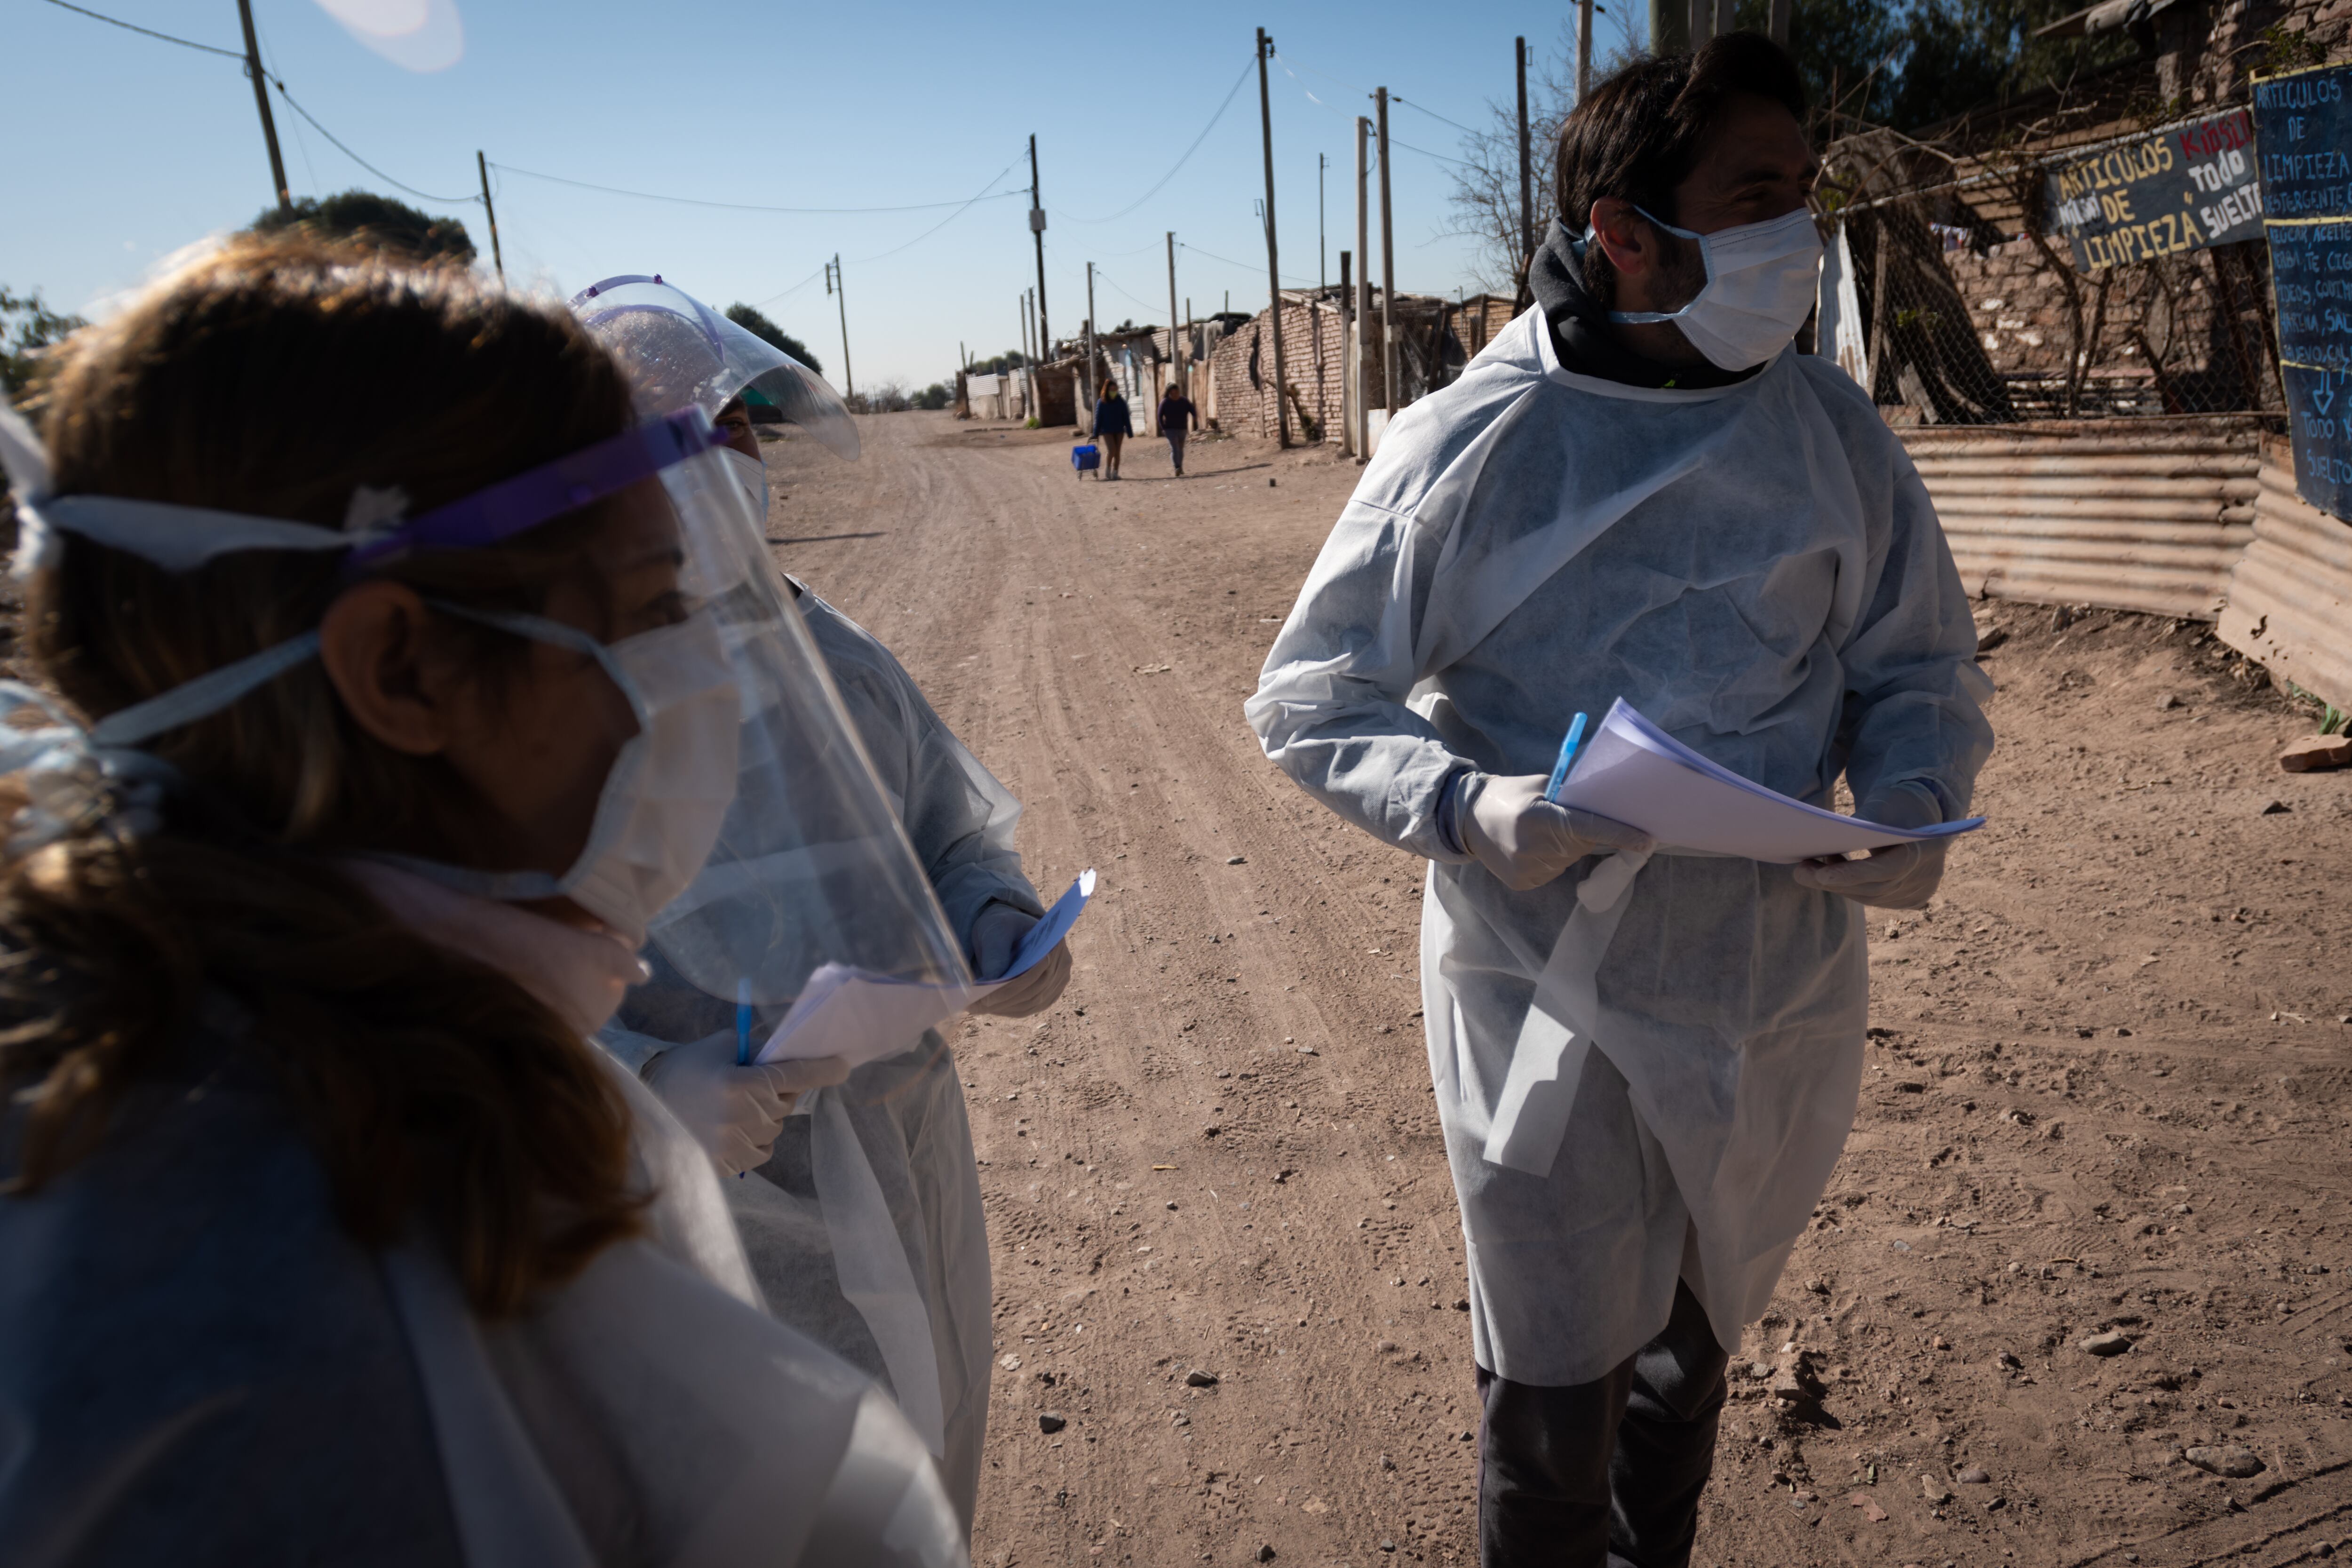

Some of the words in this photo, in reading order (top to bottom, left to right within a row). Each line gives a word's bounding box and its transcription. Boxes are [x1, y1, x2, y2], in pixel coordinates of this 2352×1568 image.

[2257, 78, 2342, 109] ARTICULOS
[2288, 116, 2305, 143] DE
[2058, 136, 2173, 201] ARTICULOS
[2264, 151, 2350, 182] LIMPIEZA
[2101, 189, 2135, 225] DE
[2307, 448, 2352, 485] SUELTO
